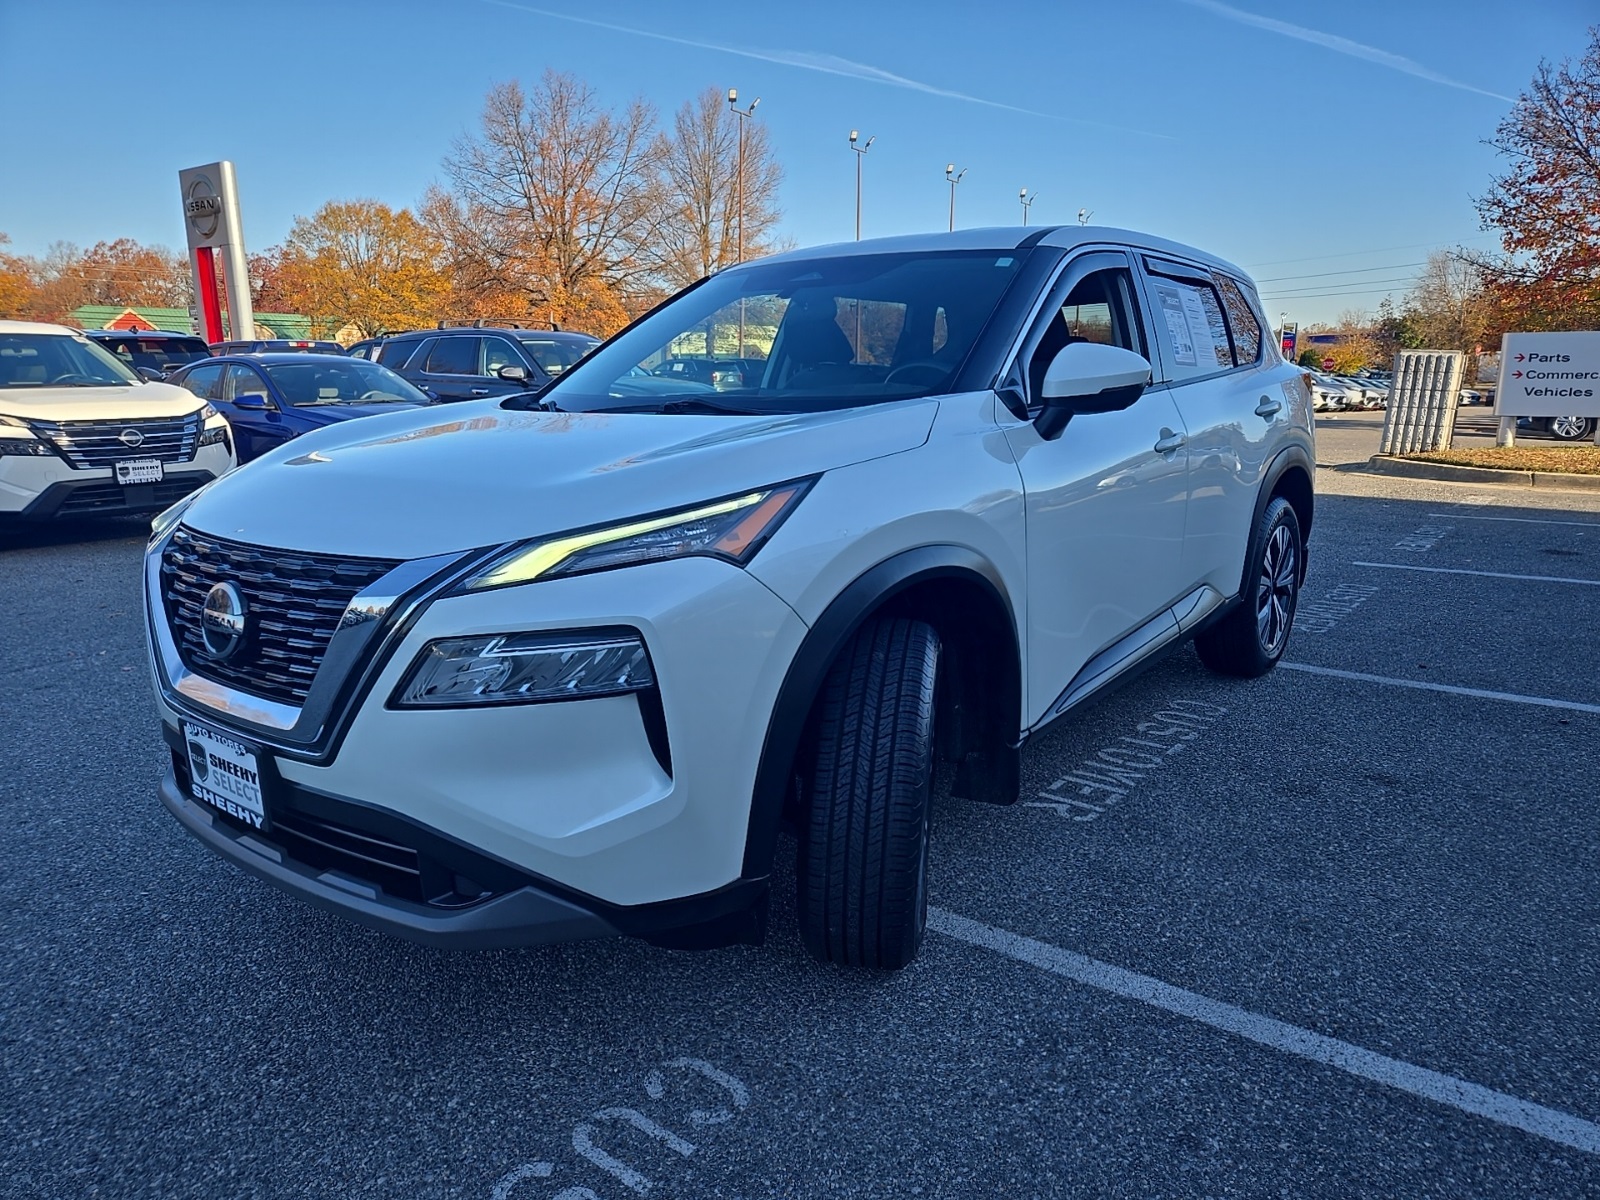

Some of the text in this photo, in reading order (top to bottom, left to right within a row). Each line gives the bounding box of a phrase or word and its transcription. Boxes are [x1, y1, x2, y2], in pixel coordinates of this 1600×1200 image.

[186, 199, 215, 212] SSAN
[1528, 353, 1571, 363] Parts
[1526, 370, 1600, 380] Commerc
[1524, 386, 1594, 397] Vehicles
[186, 721, 246, 754] AUTO STORES
[208, 753, 257, 785] SHEEHY
[212, 769, 260, 805] SELECT
[192, 783, 264, 829] SHEEHY
[491, 1056, 750, 1200] CU
